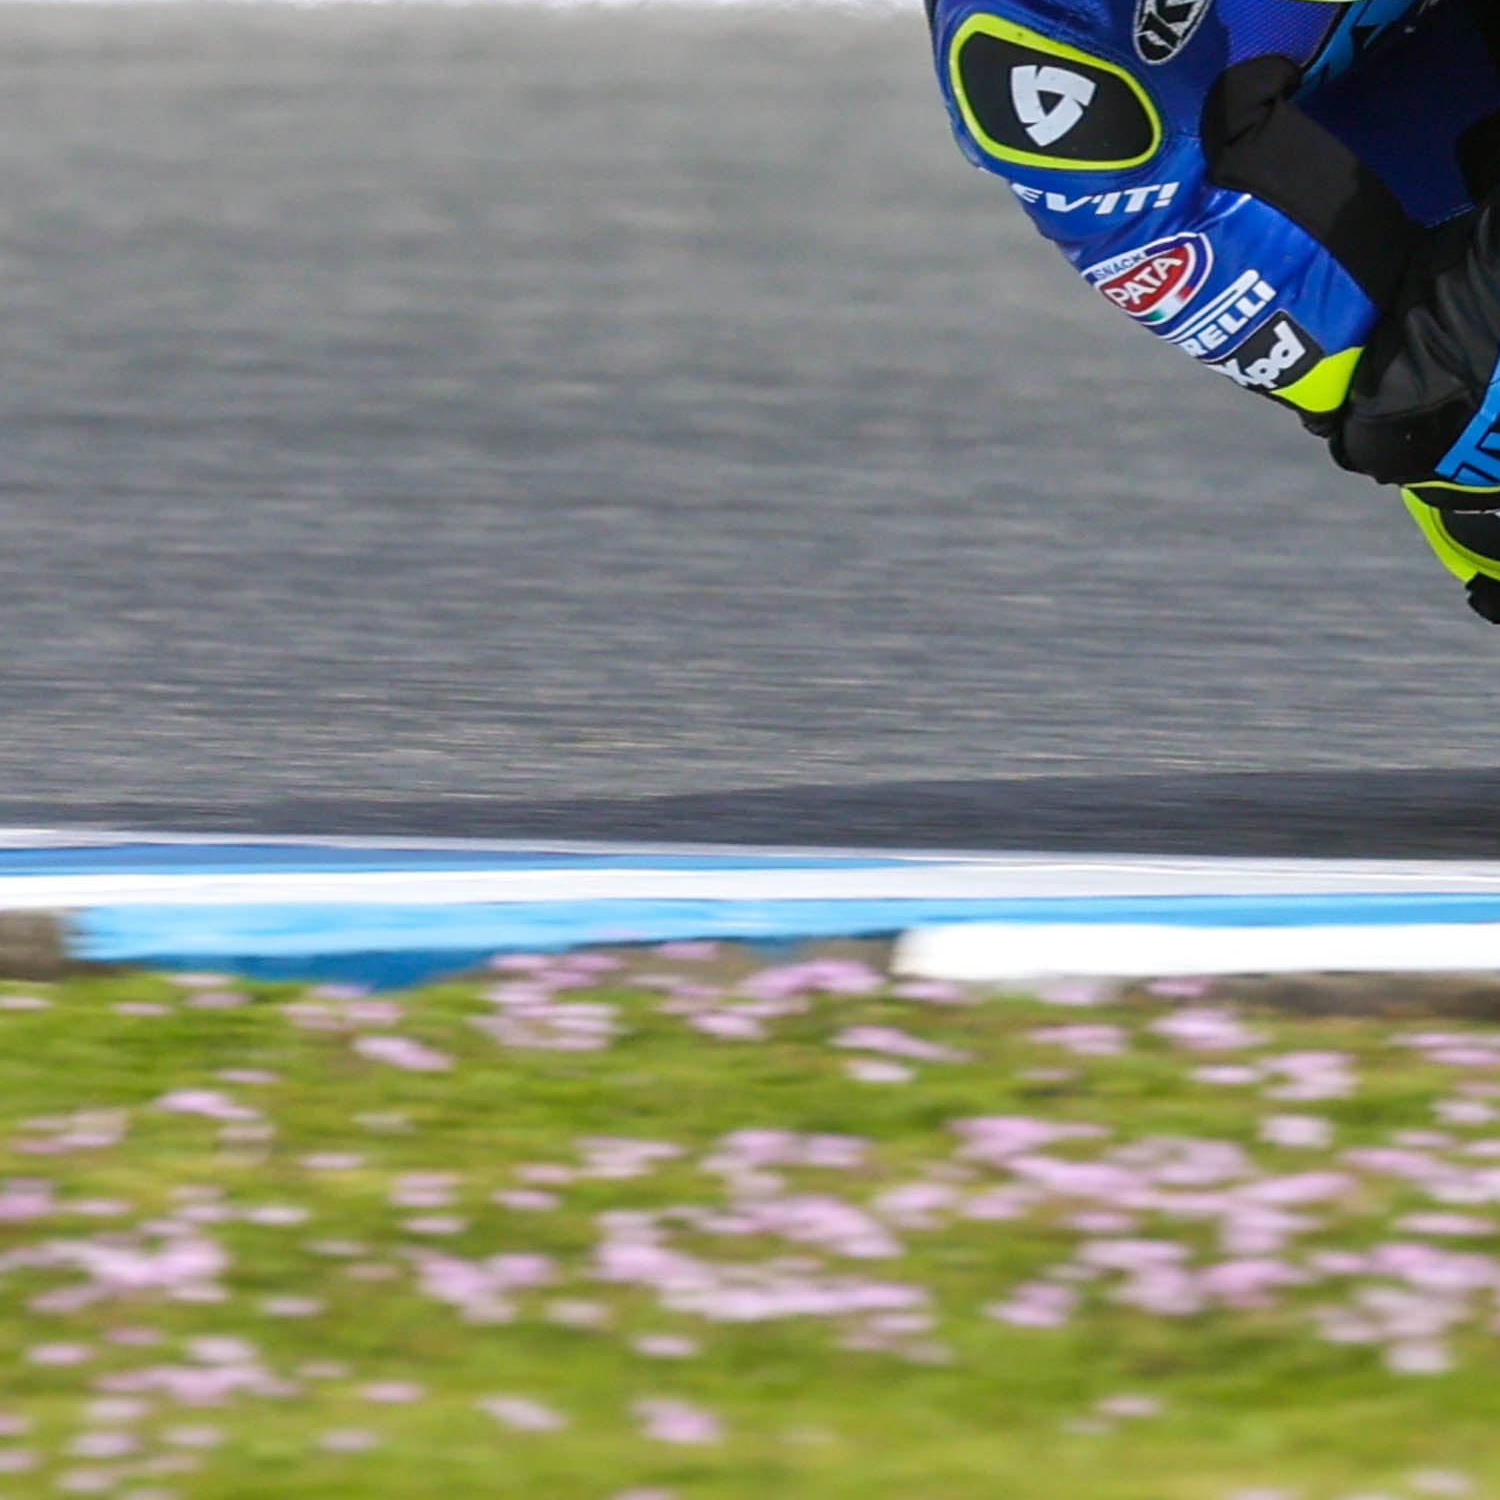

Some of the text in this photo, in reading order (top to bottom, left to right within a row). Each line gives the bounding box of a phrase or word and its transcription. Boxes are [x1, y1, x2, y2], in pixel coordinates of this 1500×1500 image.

[1011, 181, 1181, 216] EV'IT!
[1105, 255, 1185, 308] PATA
[1179, 279, 1278, 357] RELLI
